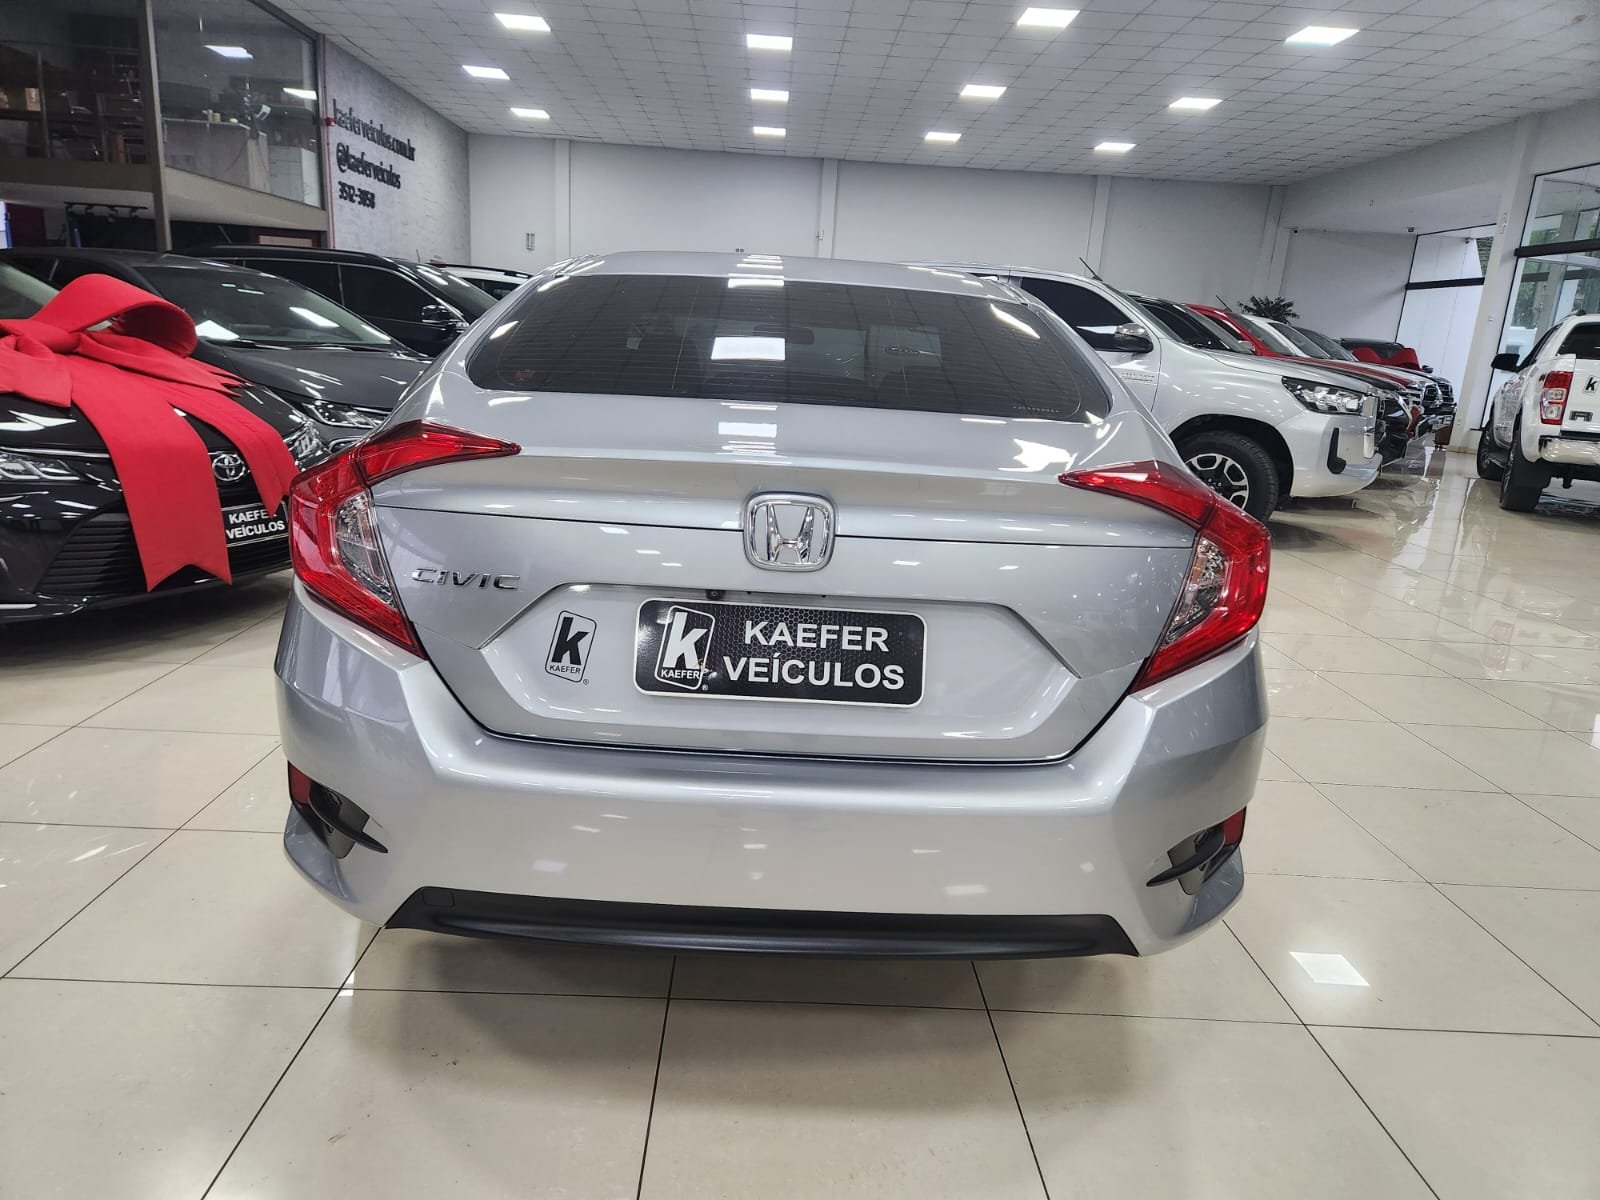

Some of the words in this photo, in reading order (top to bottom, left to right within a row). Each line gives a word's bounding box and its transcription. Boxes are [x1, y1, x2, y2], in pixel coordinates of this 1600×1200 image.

[336, 142, 401, 190] @kaeferveiculos
[229, 509, 276, 524] KAEFE
[226, 520, 285, 539] VEÍCULOS
[412, 568, 520, 590] CIVIC
[744, 620, 890, 653] KAEFER
[549, 664, 582, 674] KAEFER
[661, 669, 700, 680] KAEFER
[723, 653, 905, 690] VEÍCULOS
